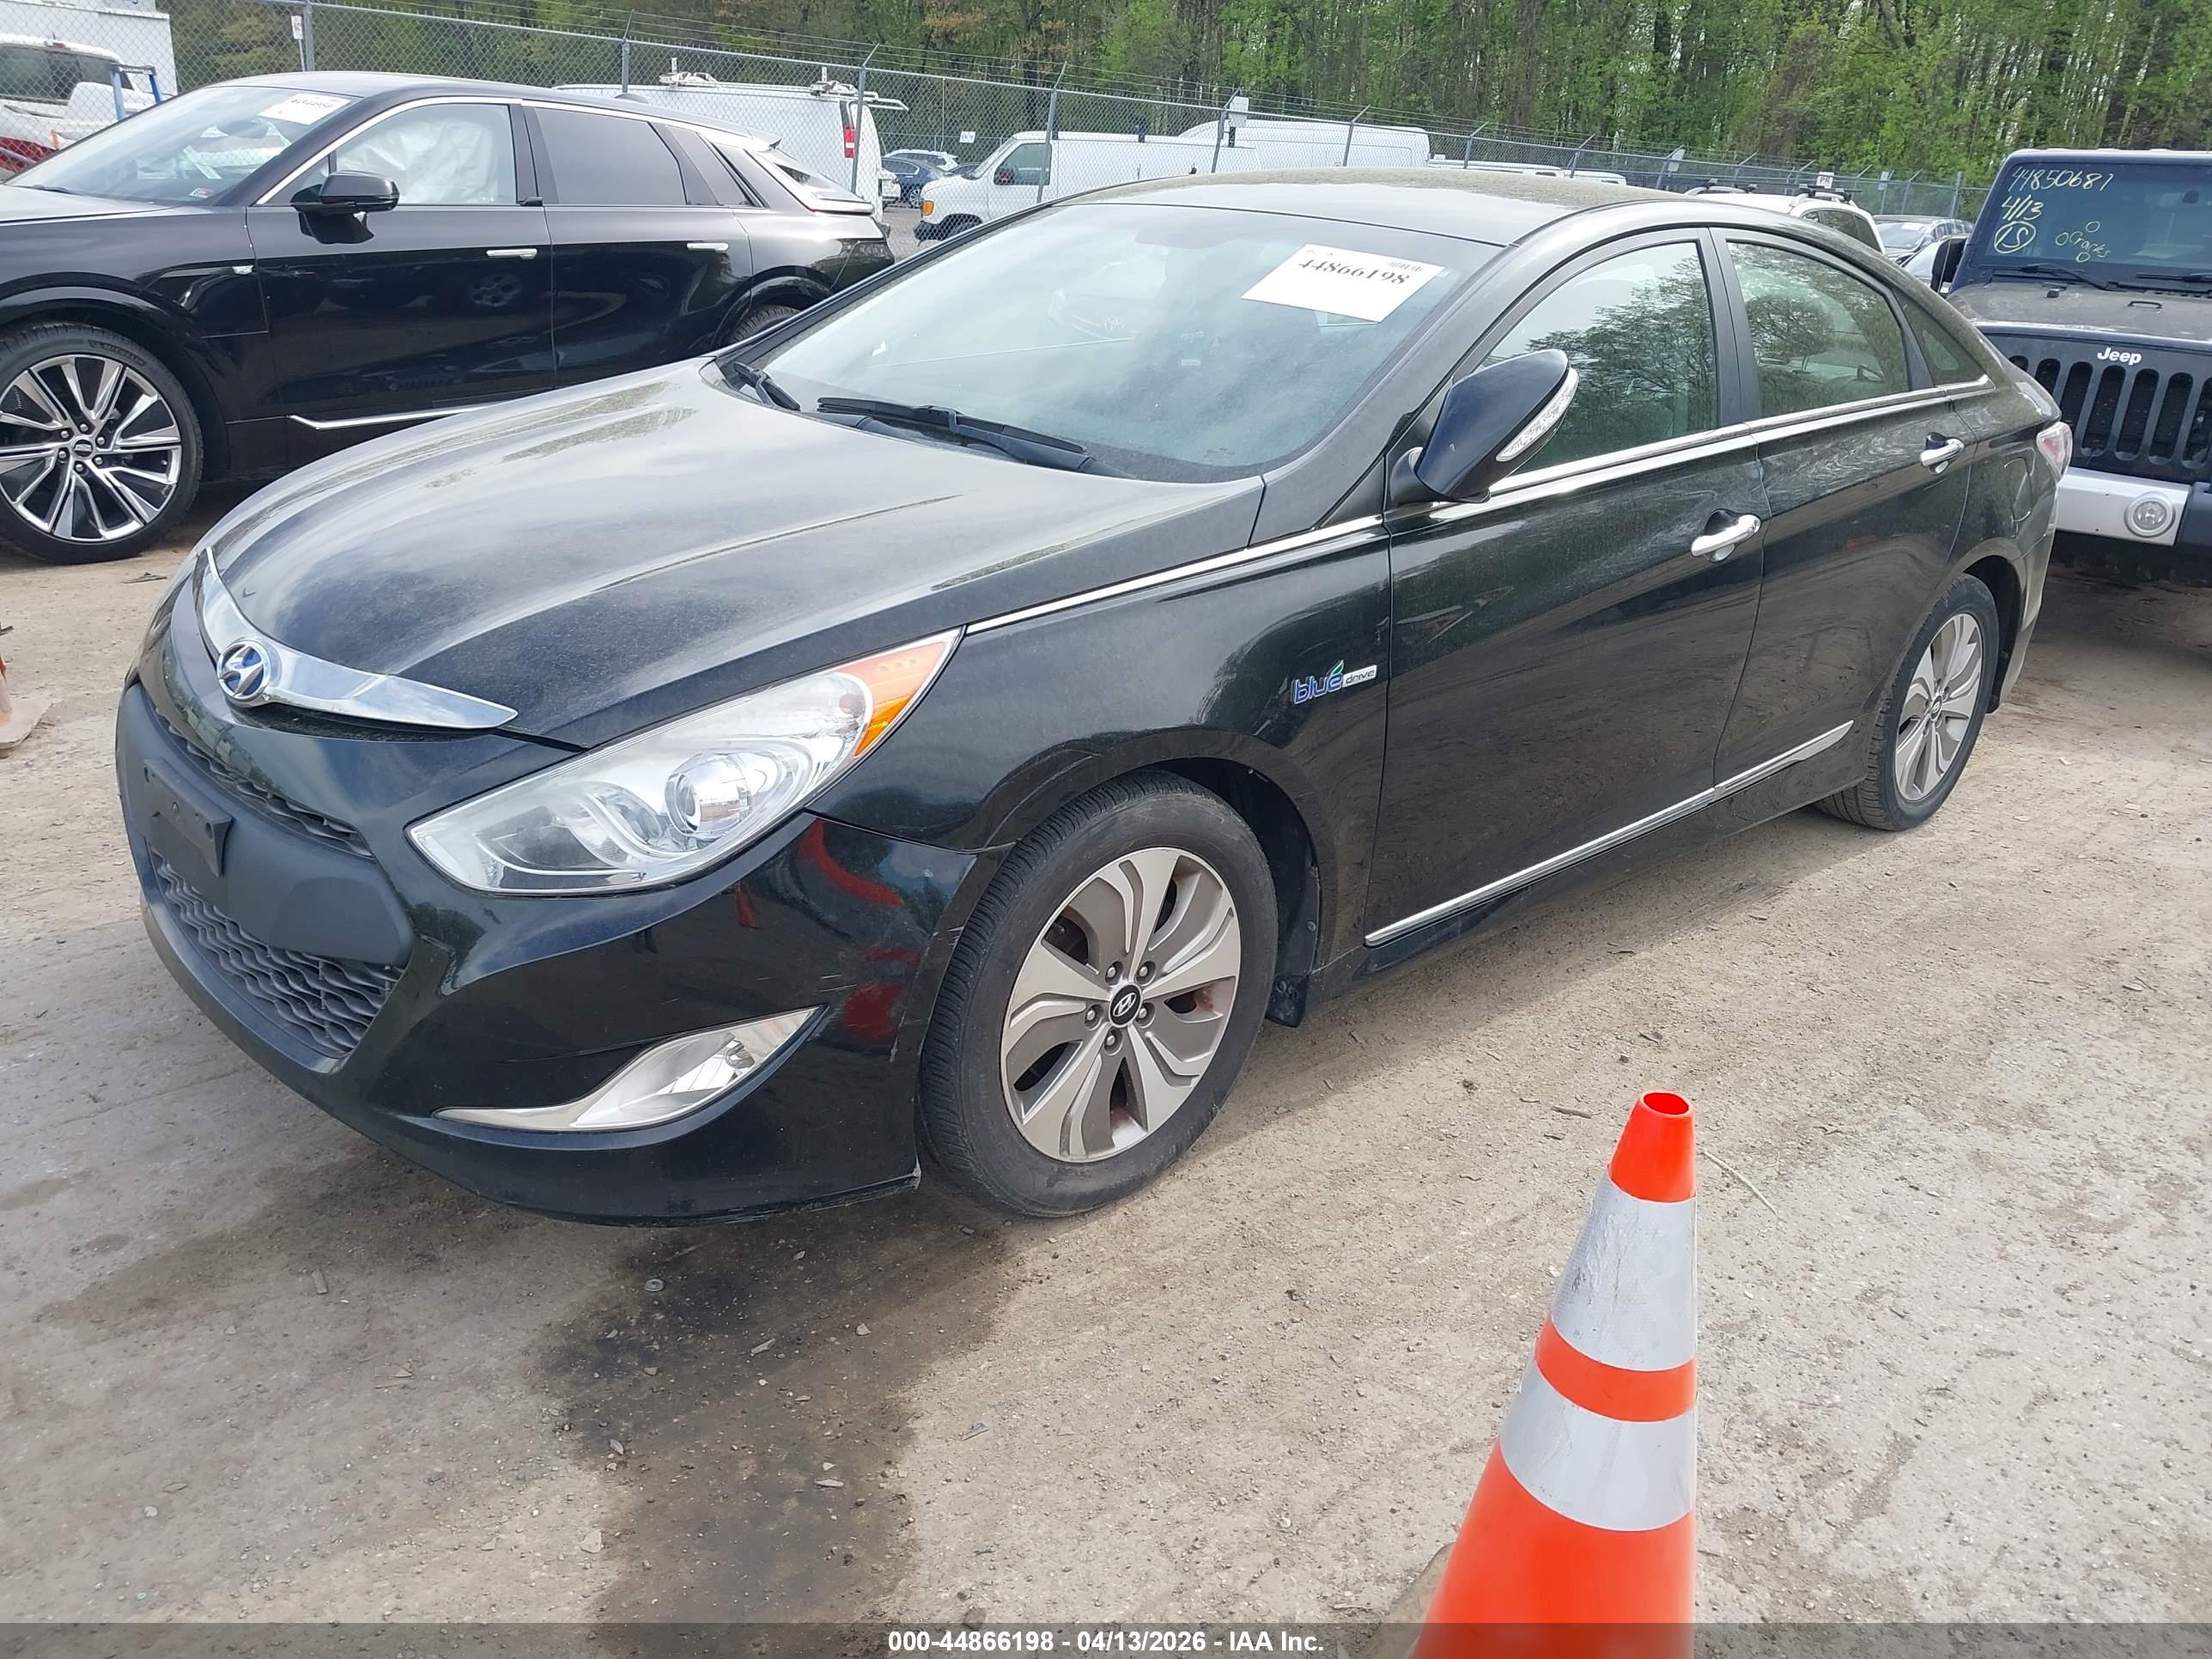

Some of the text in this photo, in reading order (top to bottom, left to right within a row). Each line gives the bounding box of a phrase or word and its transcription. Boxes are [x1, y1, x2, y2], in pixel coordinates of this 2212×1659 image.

[2001, 194, 2045, 222] 4/13
[1297, 258, 1411, 285] 44866198
[2097, 347, 2142, 366] Jeep
[1345, 670, 1375, 684] drive
